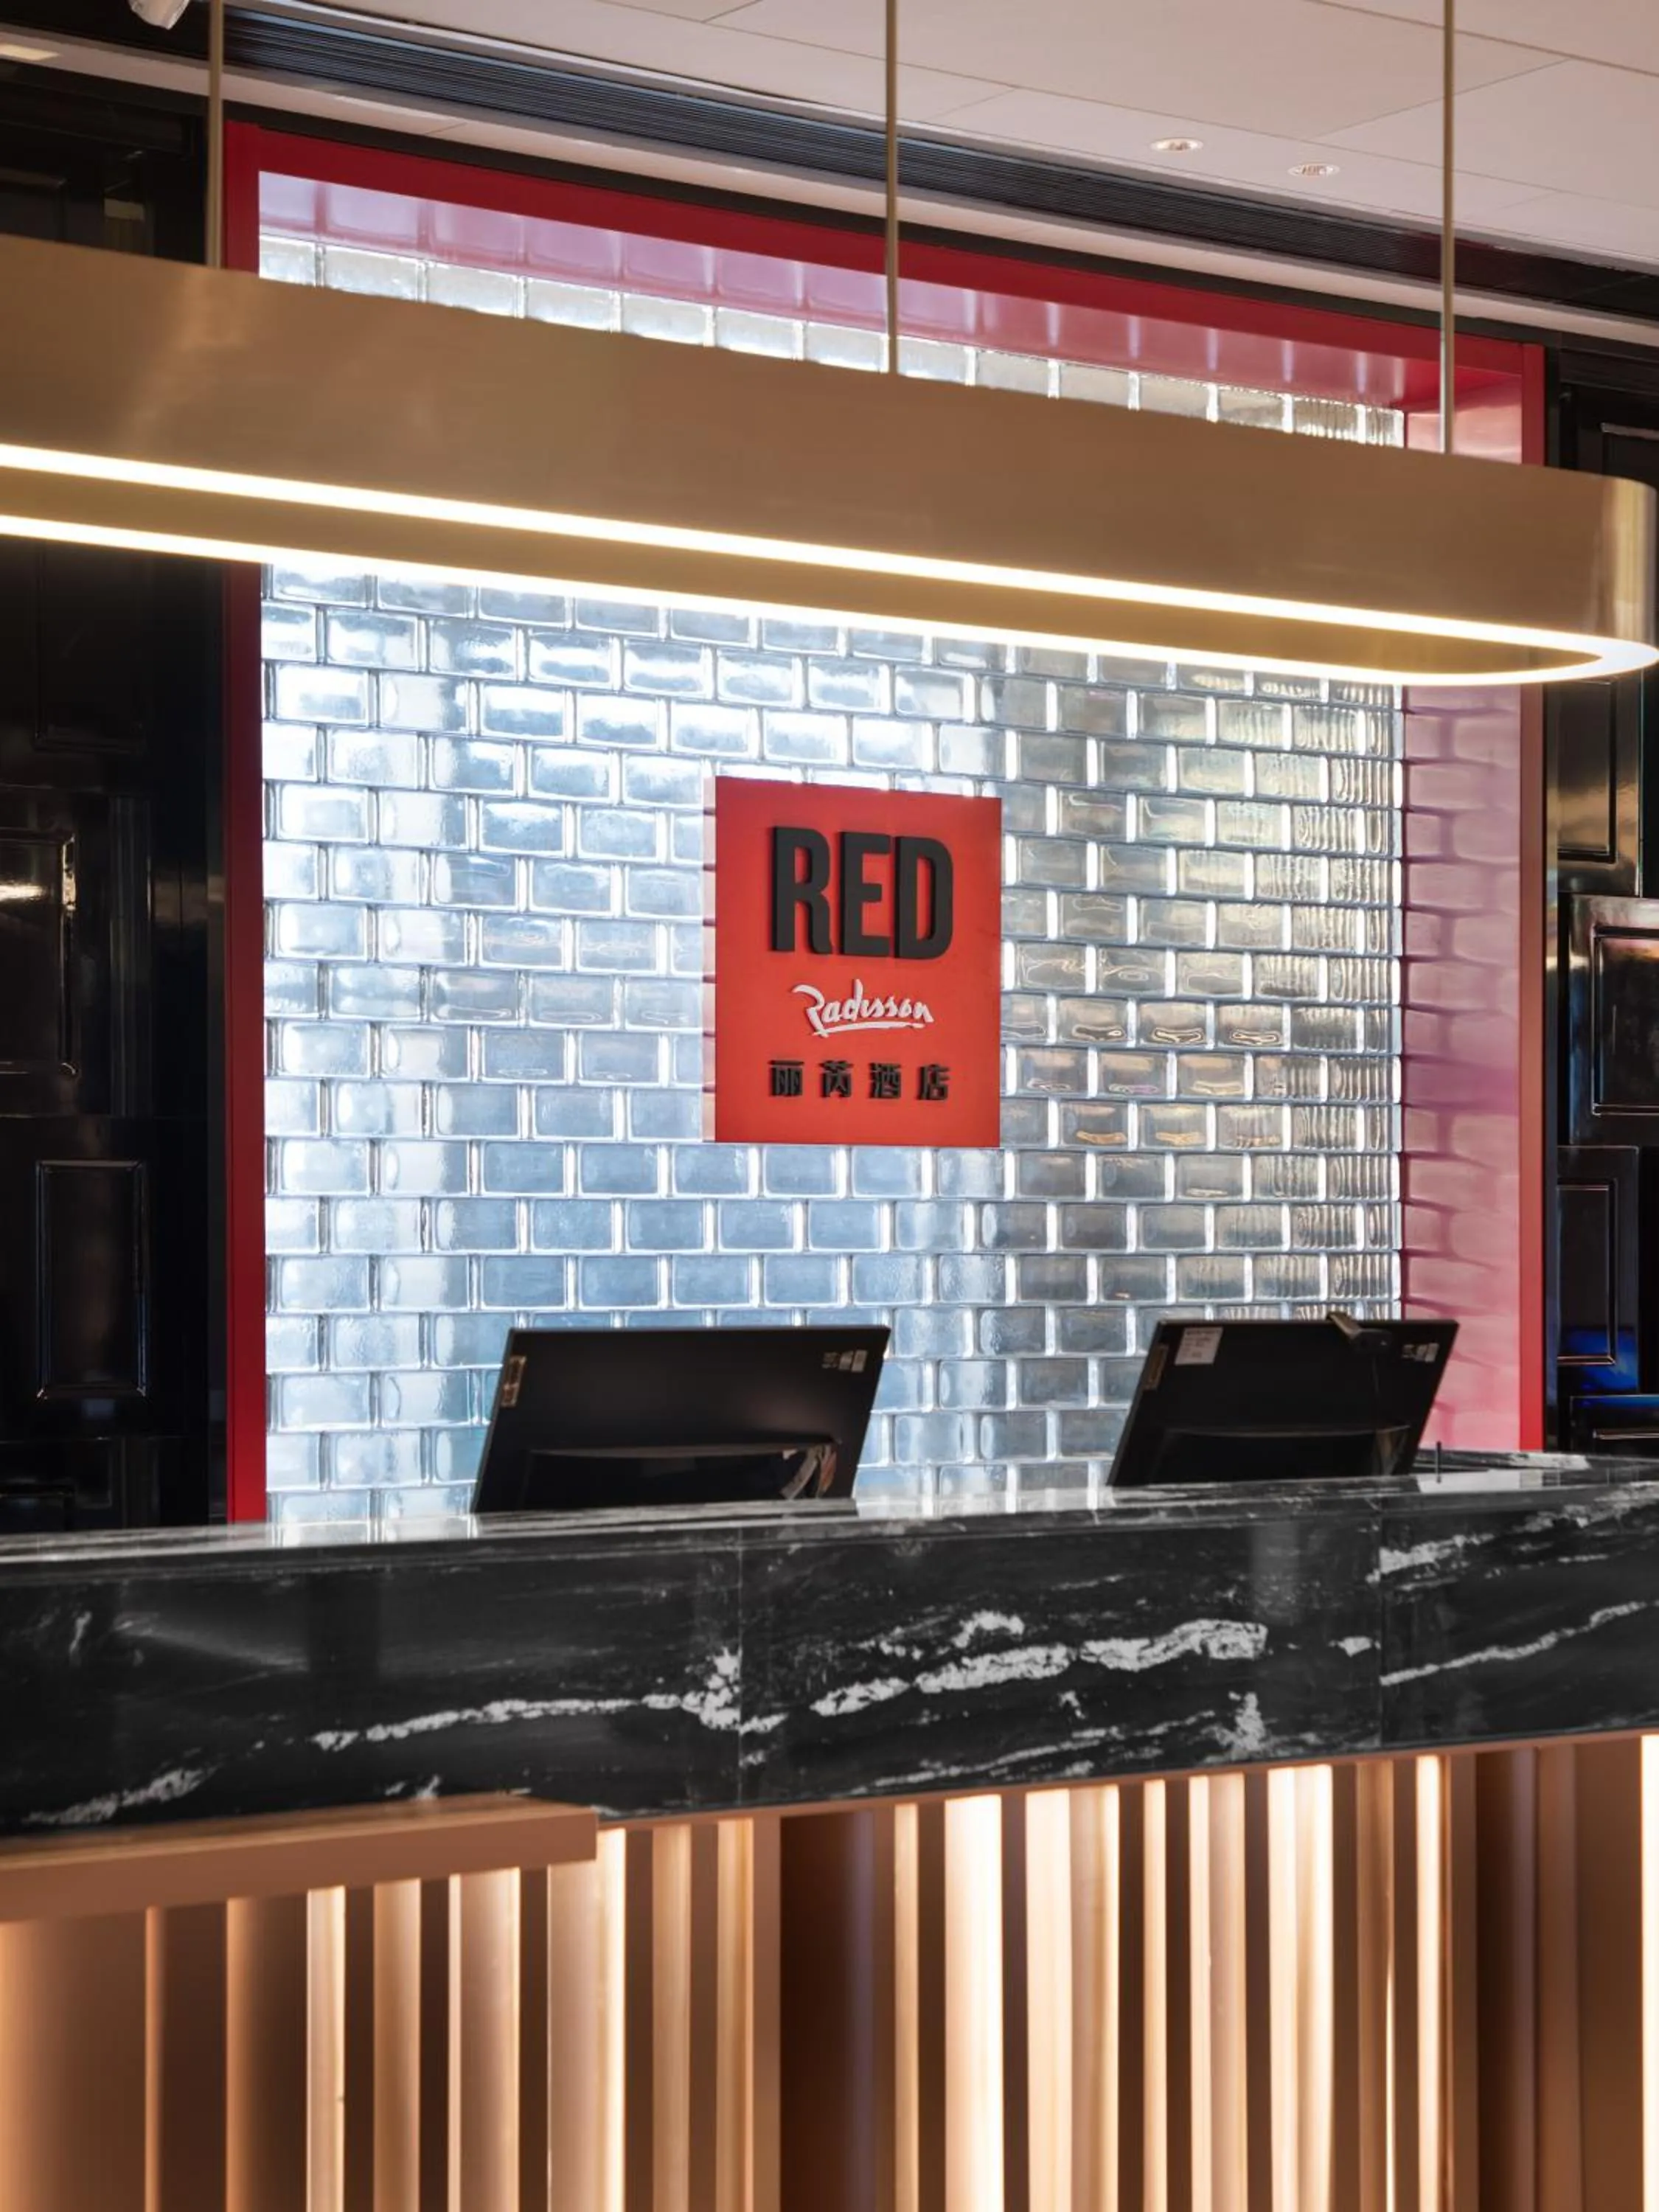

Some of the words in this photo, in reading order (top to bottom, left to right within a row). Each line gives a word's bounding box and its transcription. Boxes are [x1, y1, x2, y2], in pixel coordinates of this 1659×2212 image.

[771, 826, 953, 959] RED
[793, 979, 934, 1037] Radisson
[770, 1060, 948, 1100] 丽芮酒店
